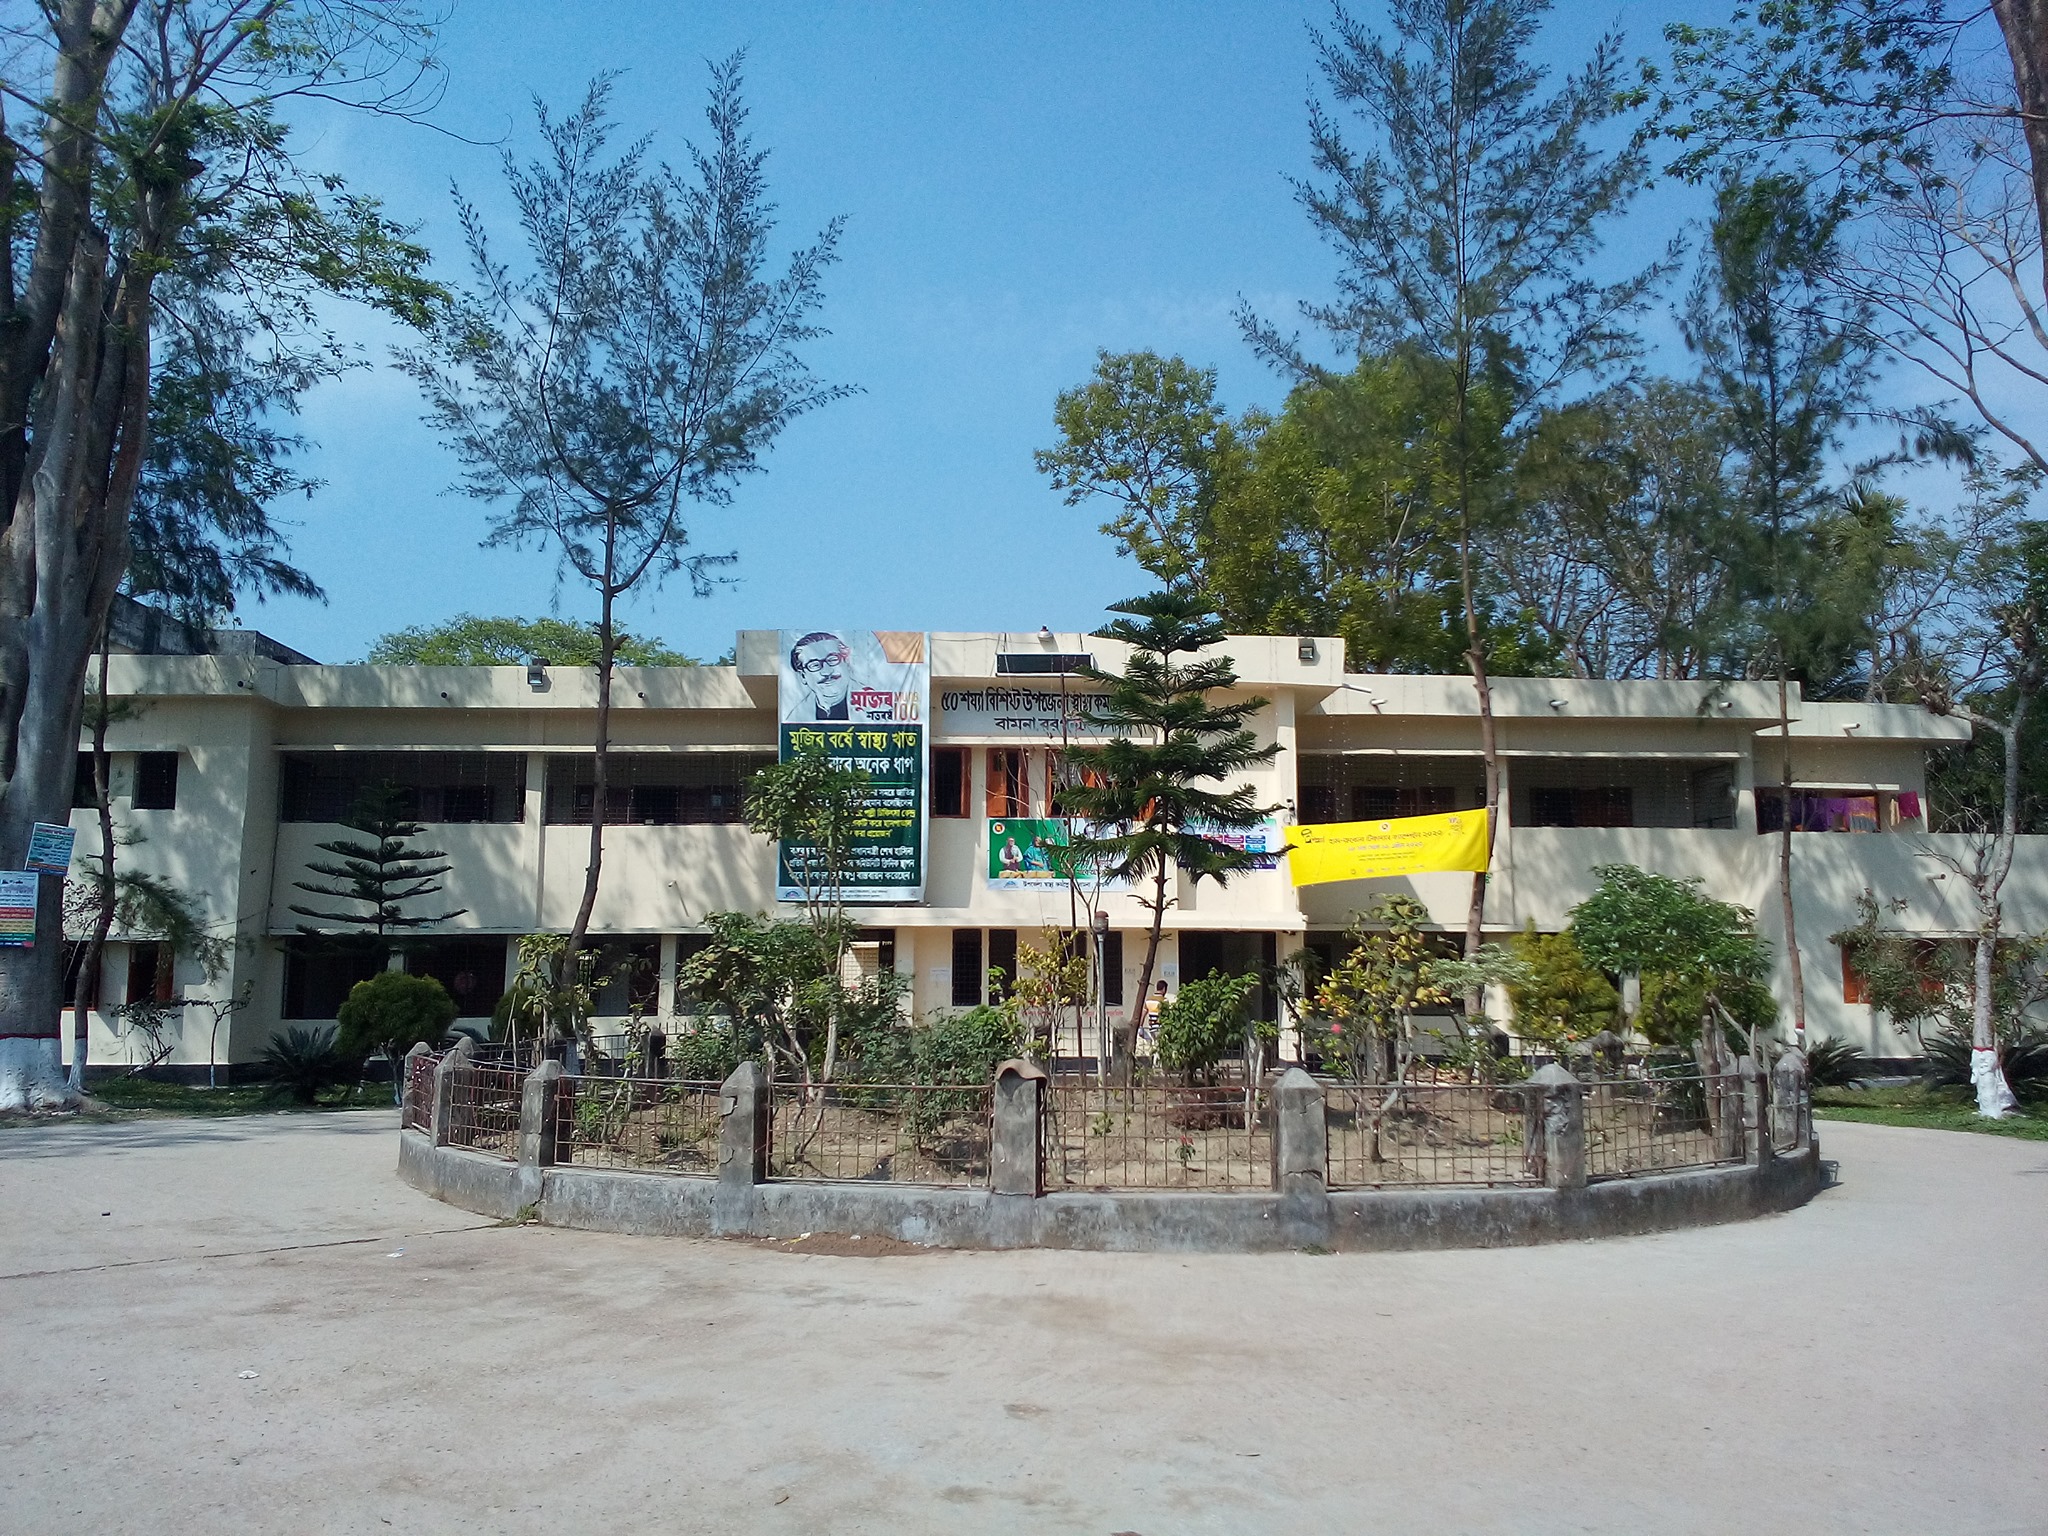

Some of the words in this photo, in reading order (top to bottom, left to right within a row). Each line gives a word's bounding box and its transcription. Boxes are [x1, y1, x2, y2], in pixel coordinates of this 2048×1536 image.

[851, 687, 893, 711] মুজিব
[941, 692, 958, 711] ৫০
[959, 690, 983, 712] শয্যা
[1022, 688, 1069, 712] উপজেলা
[894, 703, 919, 720] 100
[788, 727, 825, 751] মুজিব
[827, 726, 855, 748] বর্ষে
[855, 731, 888, 752] স্বাস্থ্য
[892, 731, 917, 748] খাত
[854, 757, 891, 774] অনেক
[893, 756, 914, 774] ধাপ
